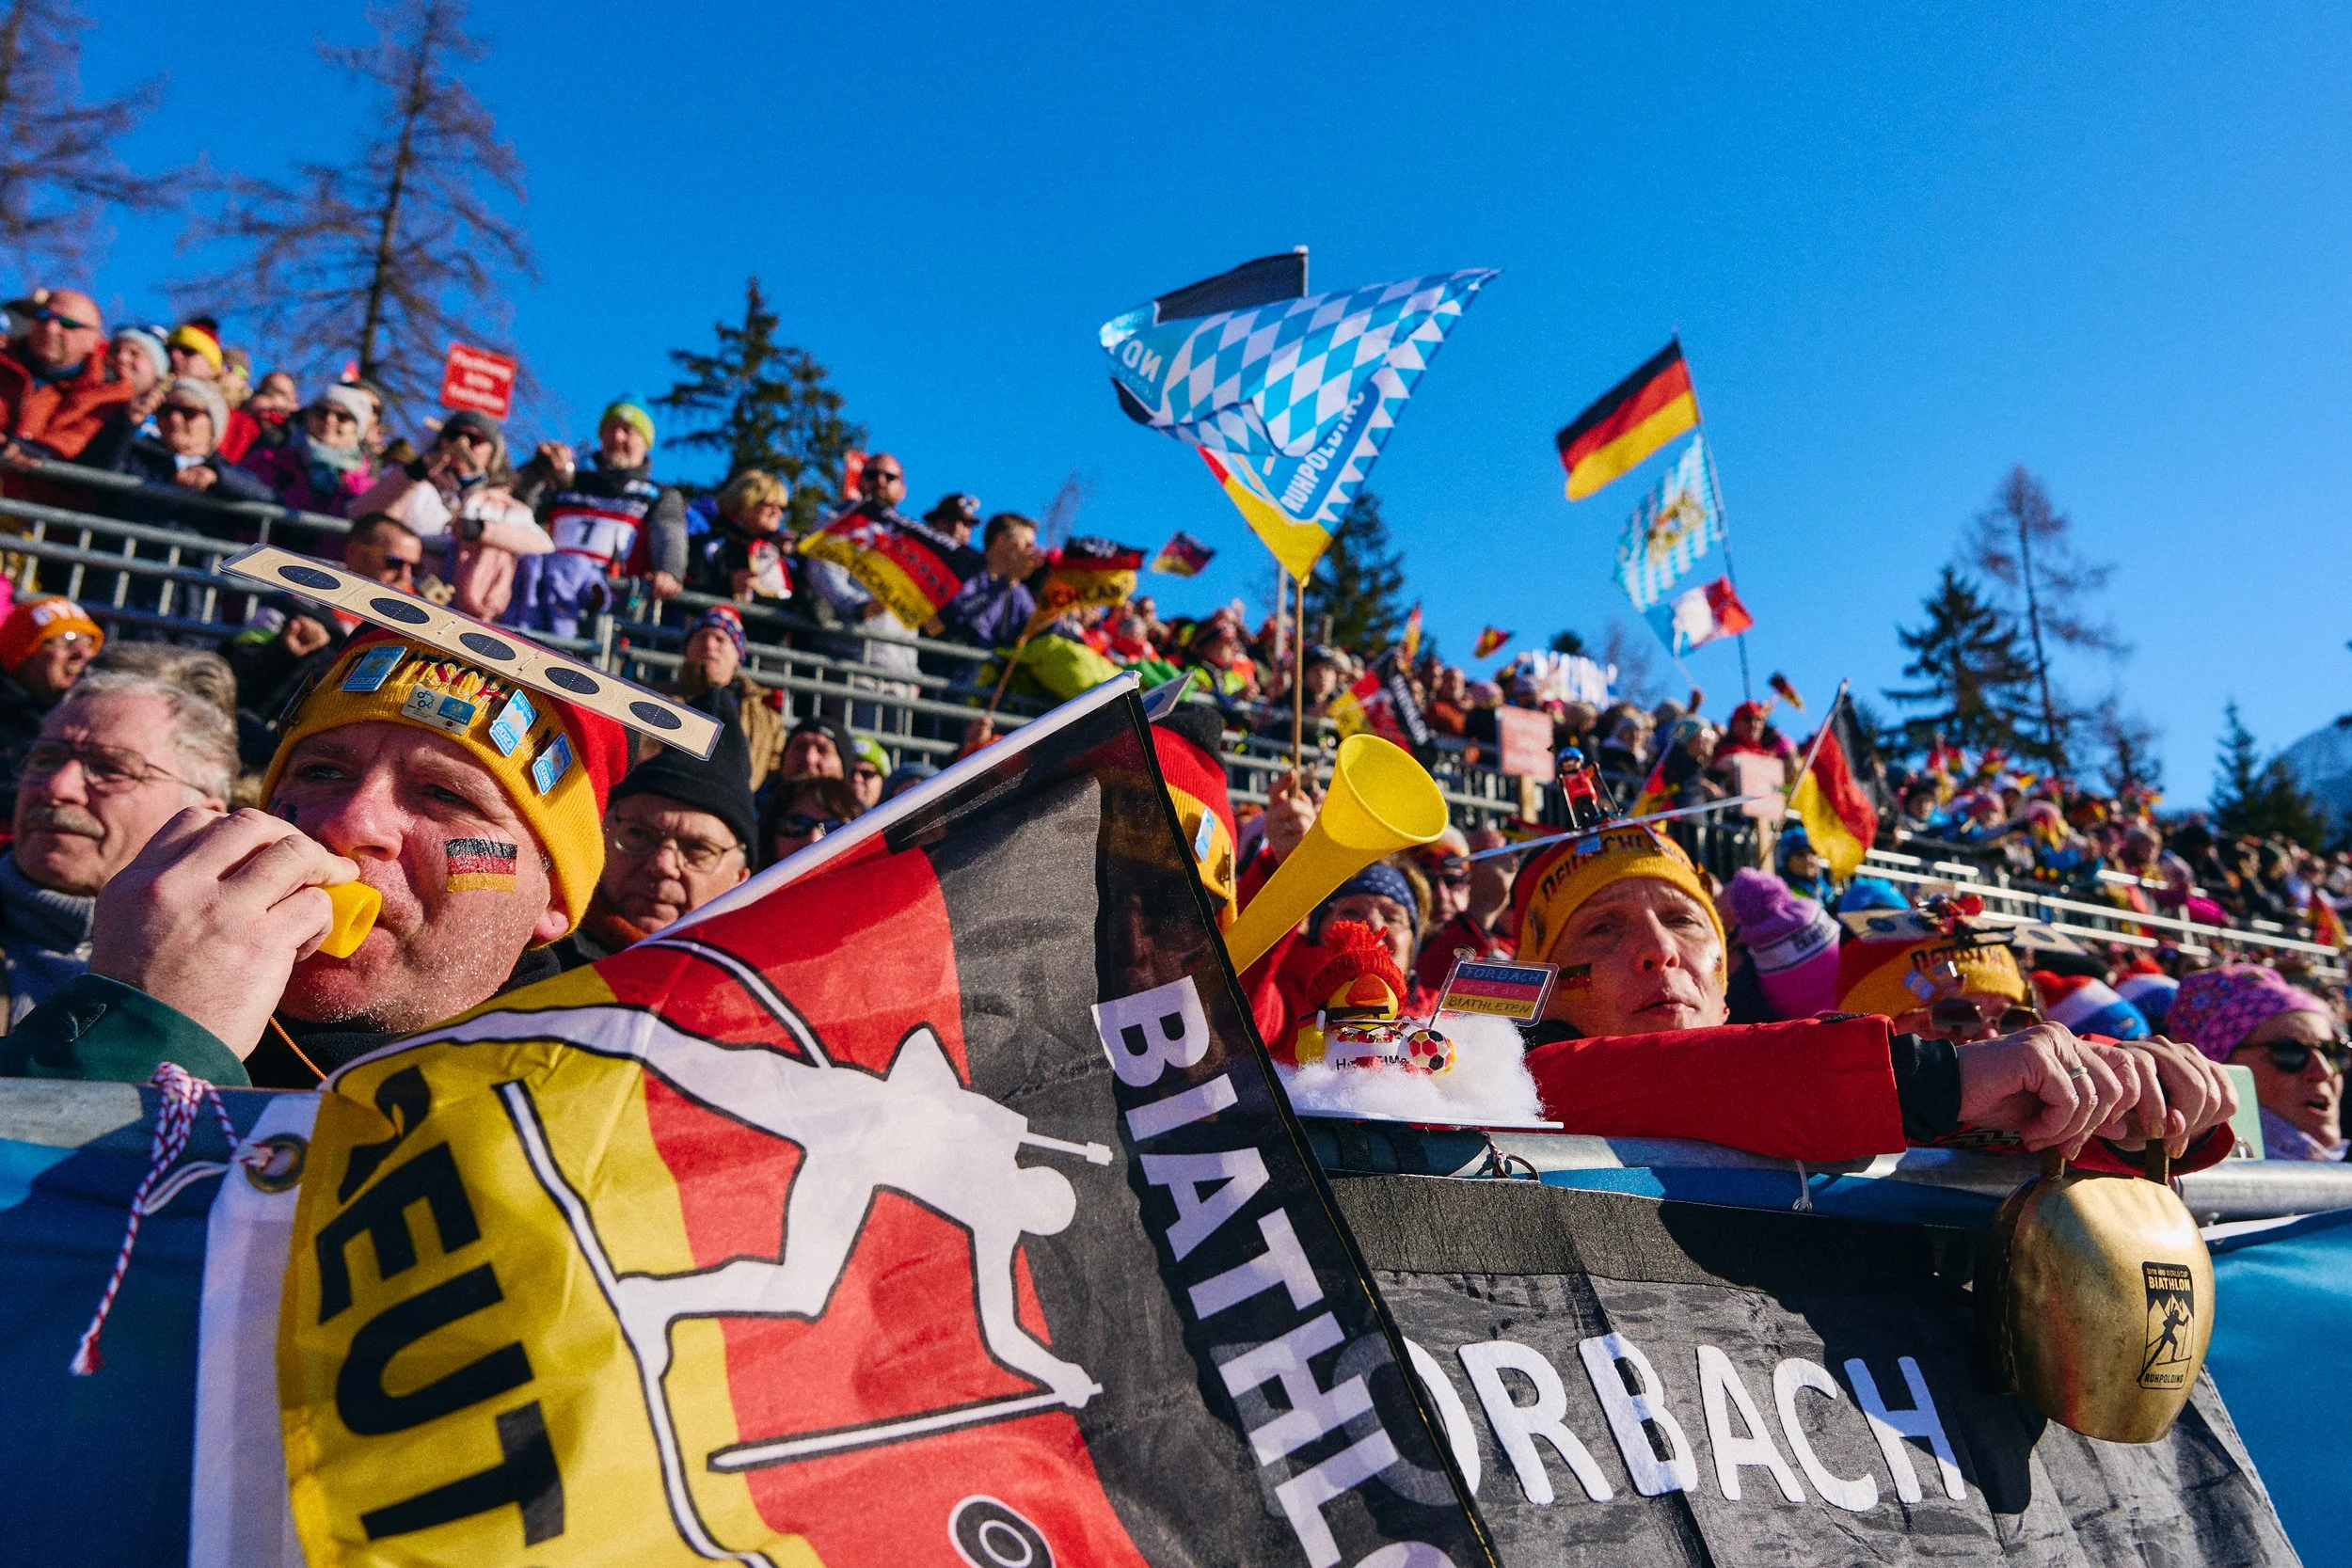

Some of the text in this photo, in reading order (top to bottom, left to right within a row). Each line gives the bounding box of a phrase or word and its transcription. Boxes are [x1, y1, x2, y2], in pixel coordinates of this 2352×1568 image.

[1463, 966, 1541, 983] FORBACH
[1447, 996, 1534, 1014] BIATHLETEN
[2148, 1275, 2191, 1292] BIATHLON
